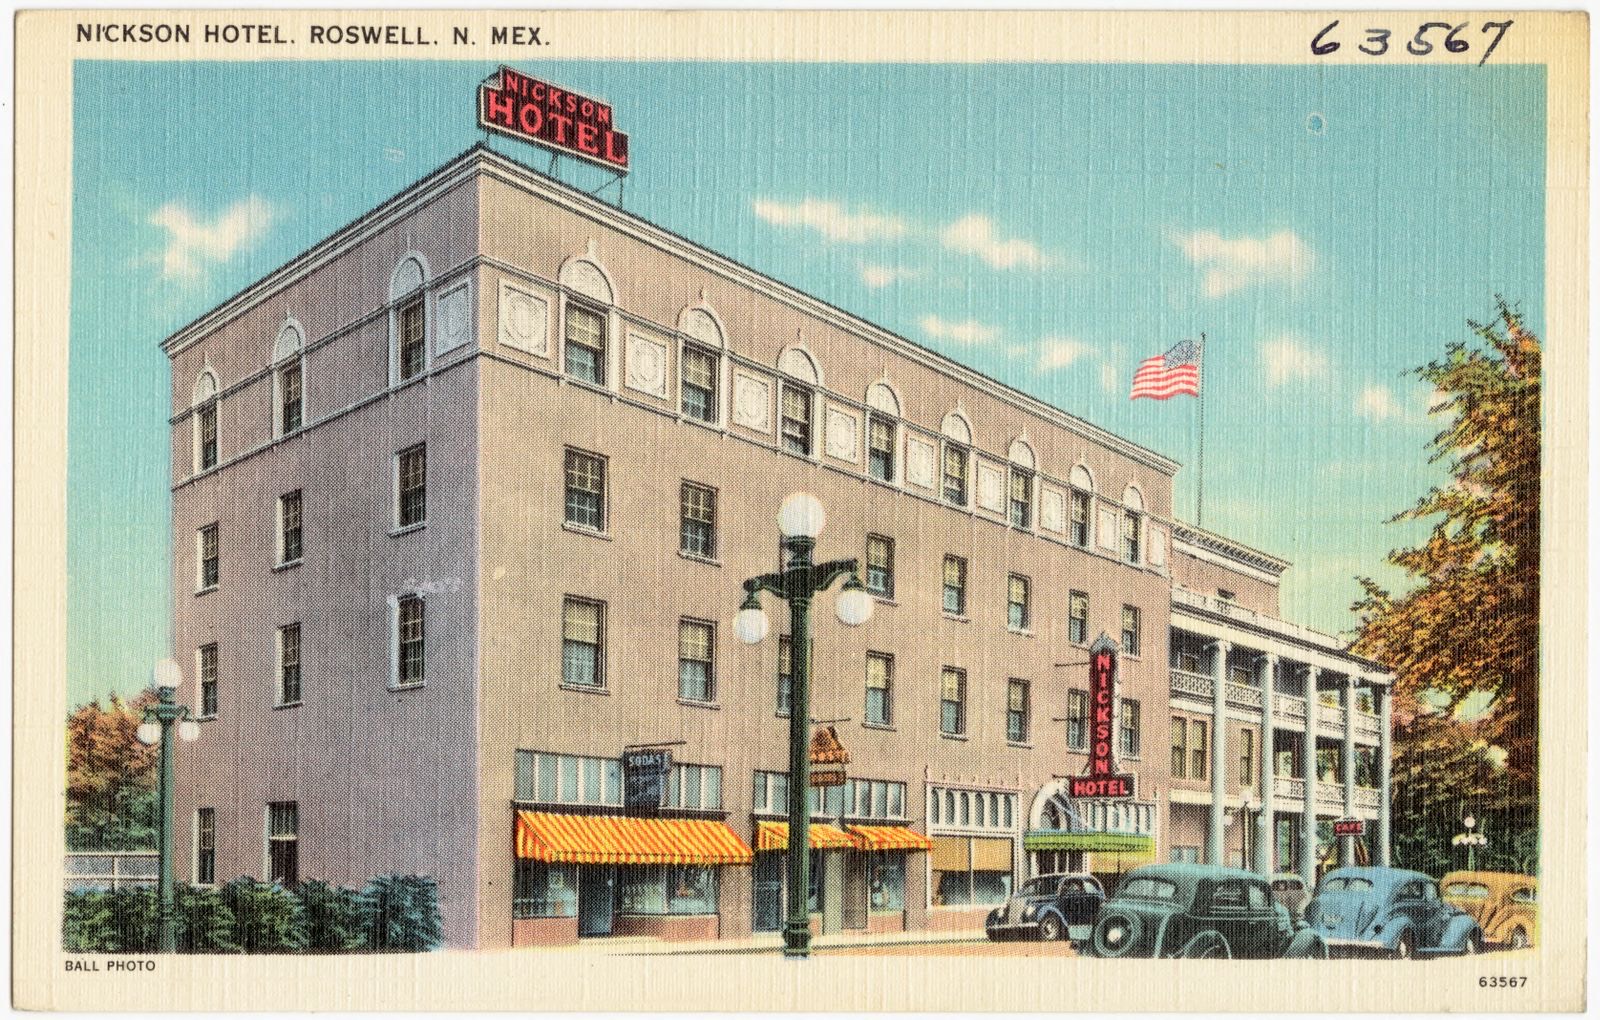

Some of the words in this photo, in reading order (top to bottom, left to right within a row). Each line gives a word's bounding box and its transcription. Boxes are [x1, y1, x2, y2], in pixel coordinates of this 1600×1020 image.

[453, 26, 476, 46] N.
[491, 26, 550, 46] MEX.
[506, 73, 610, 124] NICKSON
[488, 91, 626, 164] HOTEL
[1095, 655, 1111, 774] NICKSON
[1073, 780, 1126, 796] HOTEL
[65, 960, 99, 972] BALL
[107, 960, 156, 972] PHOTO
[1478, 976, 1528, 988] 63567
